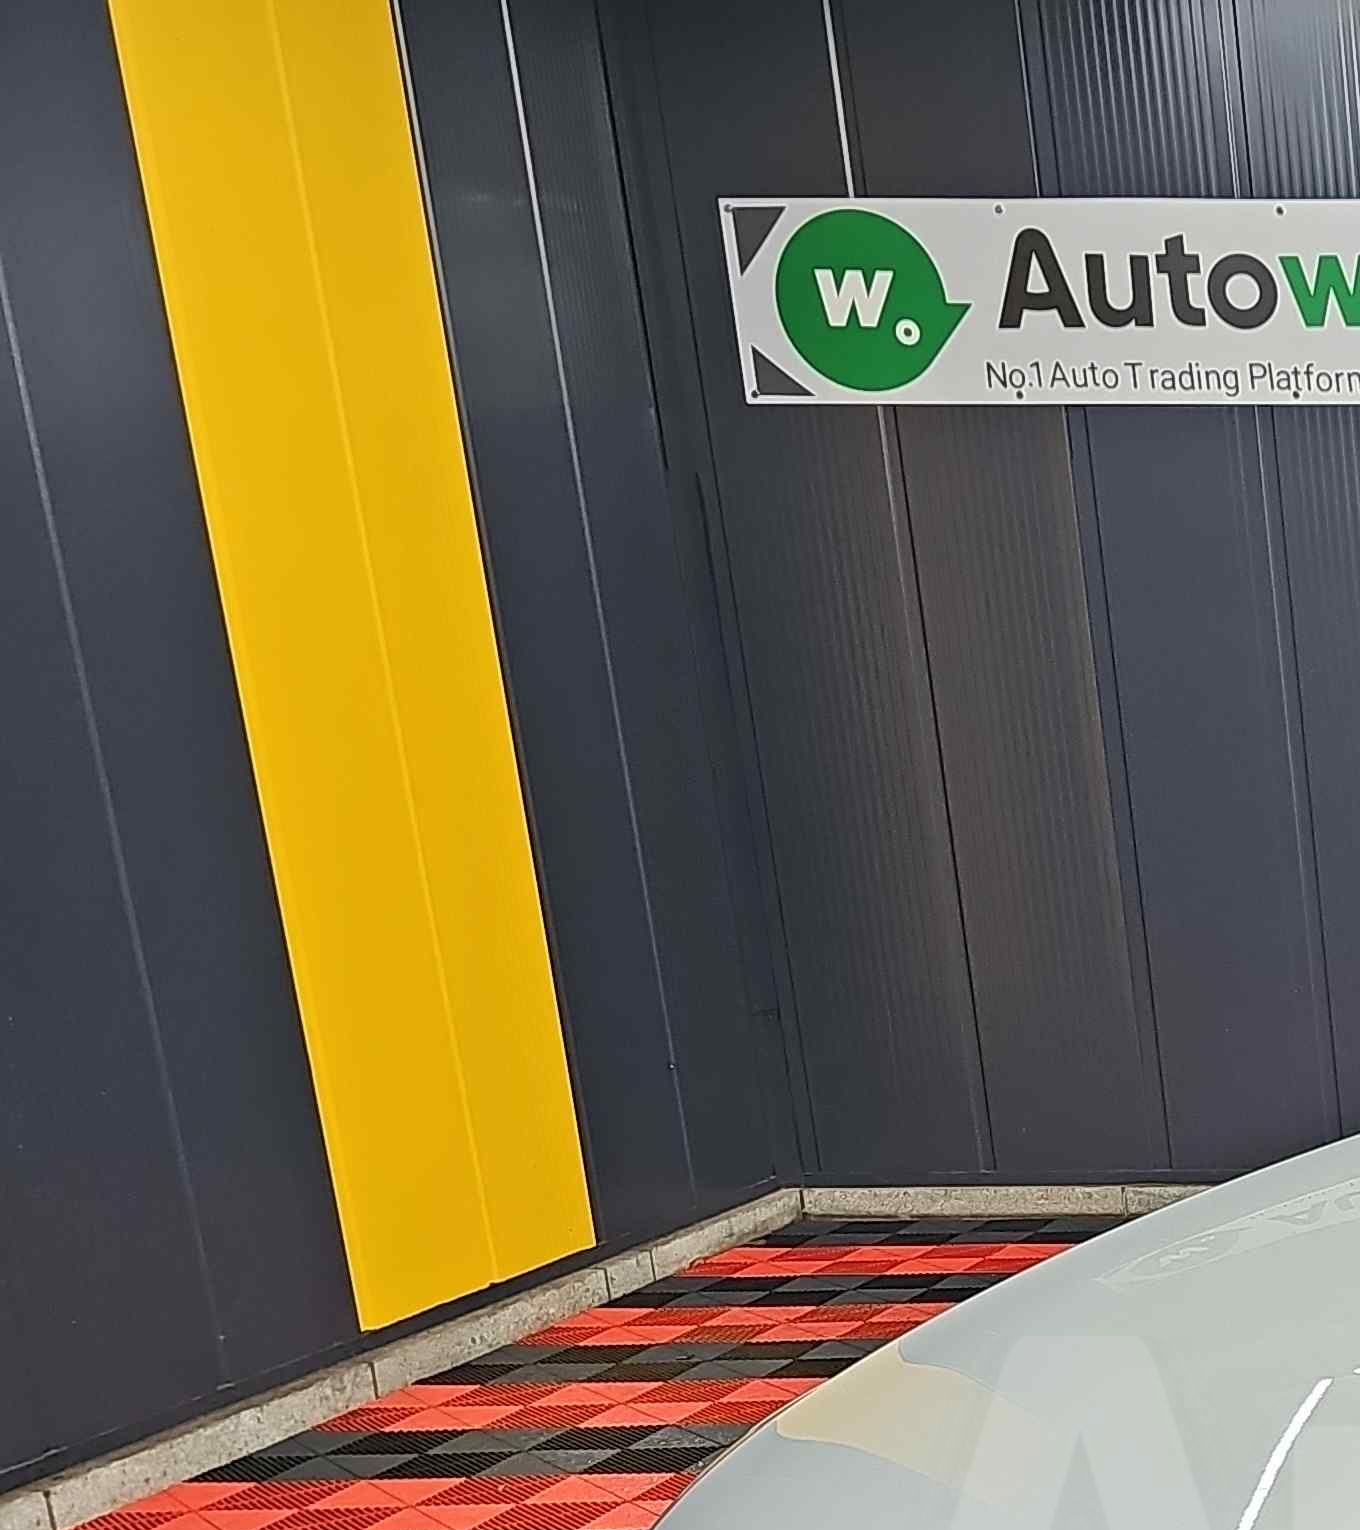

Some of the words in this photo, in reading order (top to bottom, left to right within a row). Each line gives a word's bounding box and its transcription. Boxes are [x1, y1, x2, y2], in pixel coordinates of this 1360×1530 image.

[985, 361, 1043, 390] No.1
[1050, 361, 1120, 389] Auto
[1123, 362, 1240, 397] Trading
